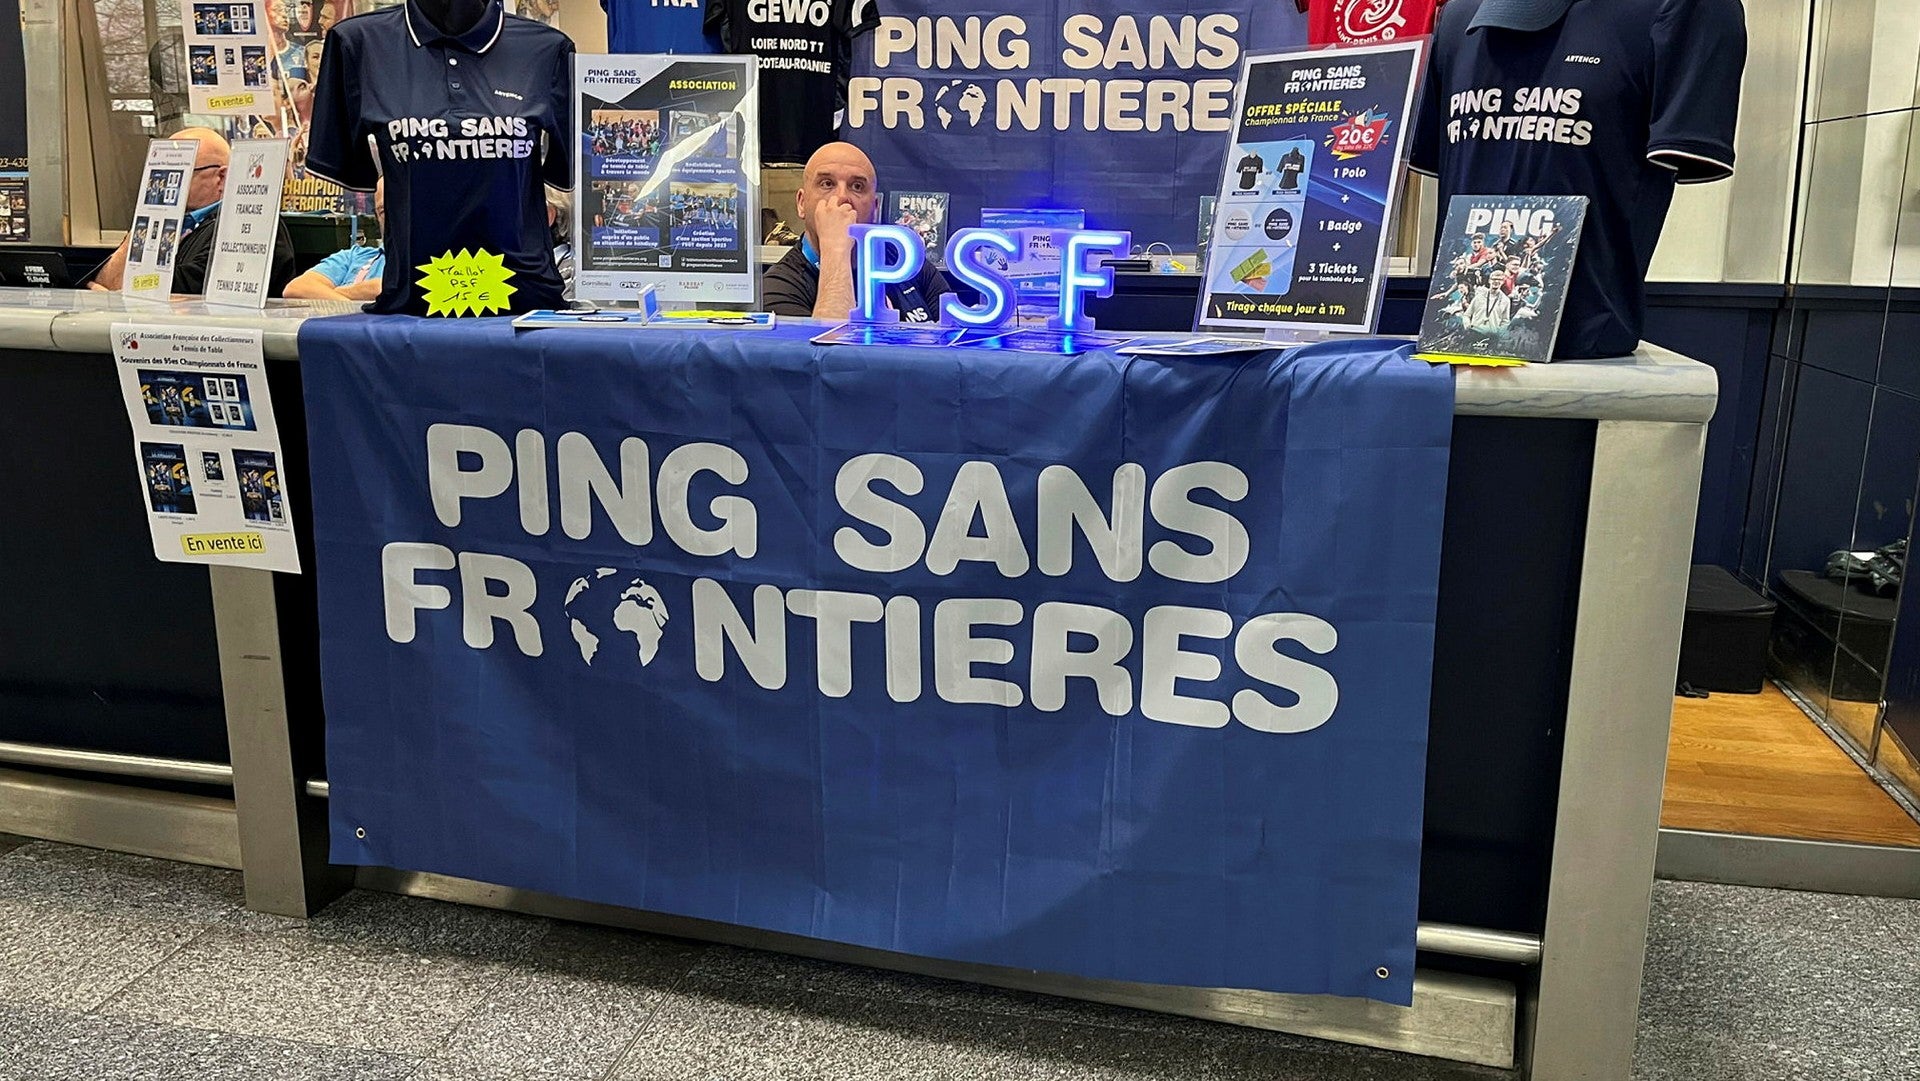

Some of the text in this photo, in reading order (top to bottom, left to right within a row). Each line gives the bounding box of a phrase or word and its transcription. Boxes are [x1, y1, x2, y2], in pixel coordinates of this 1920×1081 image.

[747, 0, 829, 27] GEWO
[751, 37, 778, 50] LOIRE
[780, 38, 808, 51] NORD
[874, 14, 1239, 70] PING SANS
[757, 56, 831, 74] COTEAU-ROANNE
[1564, 54, 1601, 65] ARTENGO
[1291, 65, 1362, 81] PING SANS
[669, 80, 736, 90] ASSOCIATION
[848, 77, 1238, 132] FRONTIERE
[1247, 98, 1342, 117] OFFRE SPÉCIALE
[1450, 87, 1582, 118] PING SANS
[1245, 114, 1339, 127] Championnat de France
[388, 116, 528, 141] PING SANS
[1338, 128, 1375, 145] 20€
[1333, 166, 1367, 178] 1 Polo
[236, 184, 269, 195] ASSOCIATION
[241, 223, 251, 234] DES
[1319, 220, 1325, 230] 1
[1465, 209, 1555, 237] PING
[221, 242, 267, 254] COLLECTIONNEURS
[437, 265, 485, 276] Maillot
[1308, 262, 1358, 274] 3 Tickets
[216, 280, 234, 292] TENNIS
[242, 282, 259, 294] TABLE
[450, 278, 477, 288] PSF
[1226, 301, 1346, 316] Tirage chaque jour à 17h
[140, 332, 254, 344] Association Française des Collectionneurs
[208, 346, 223, 354] Table
[120, 356, 150, 364] Souvenirs
[180, 358, 226, 368] Championnats
[227, 360, 235, 368] de
[236, 360, 258, 370] France
[426, 423, 1250, 582] PING SANS
[187, 534, 263, 551] En vente ici
